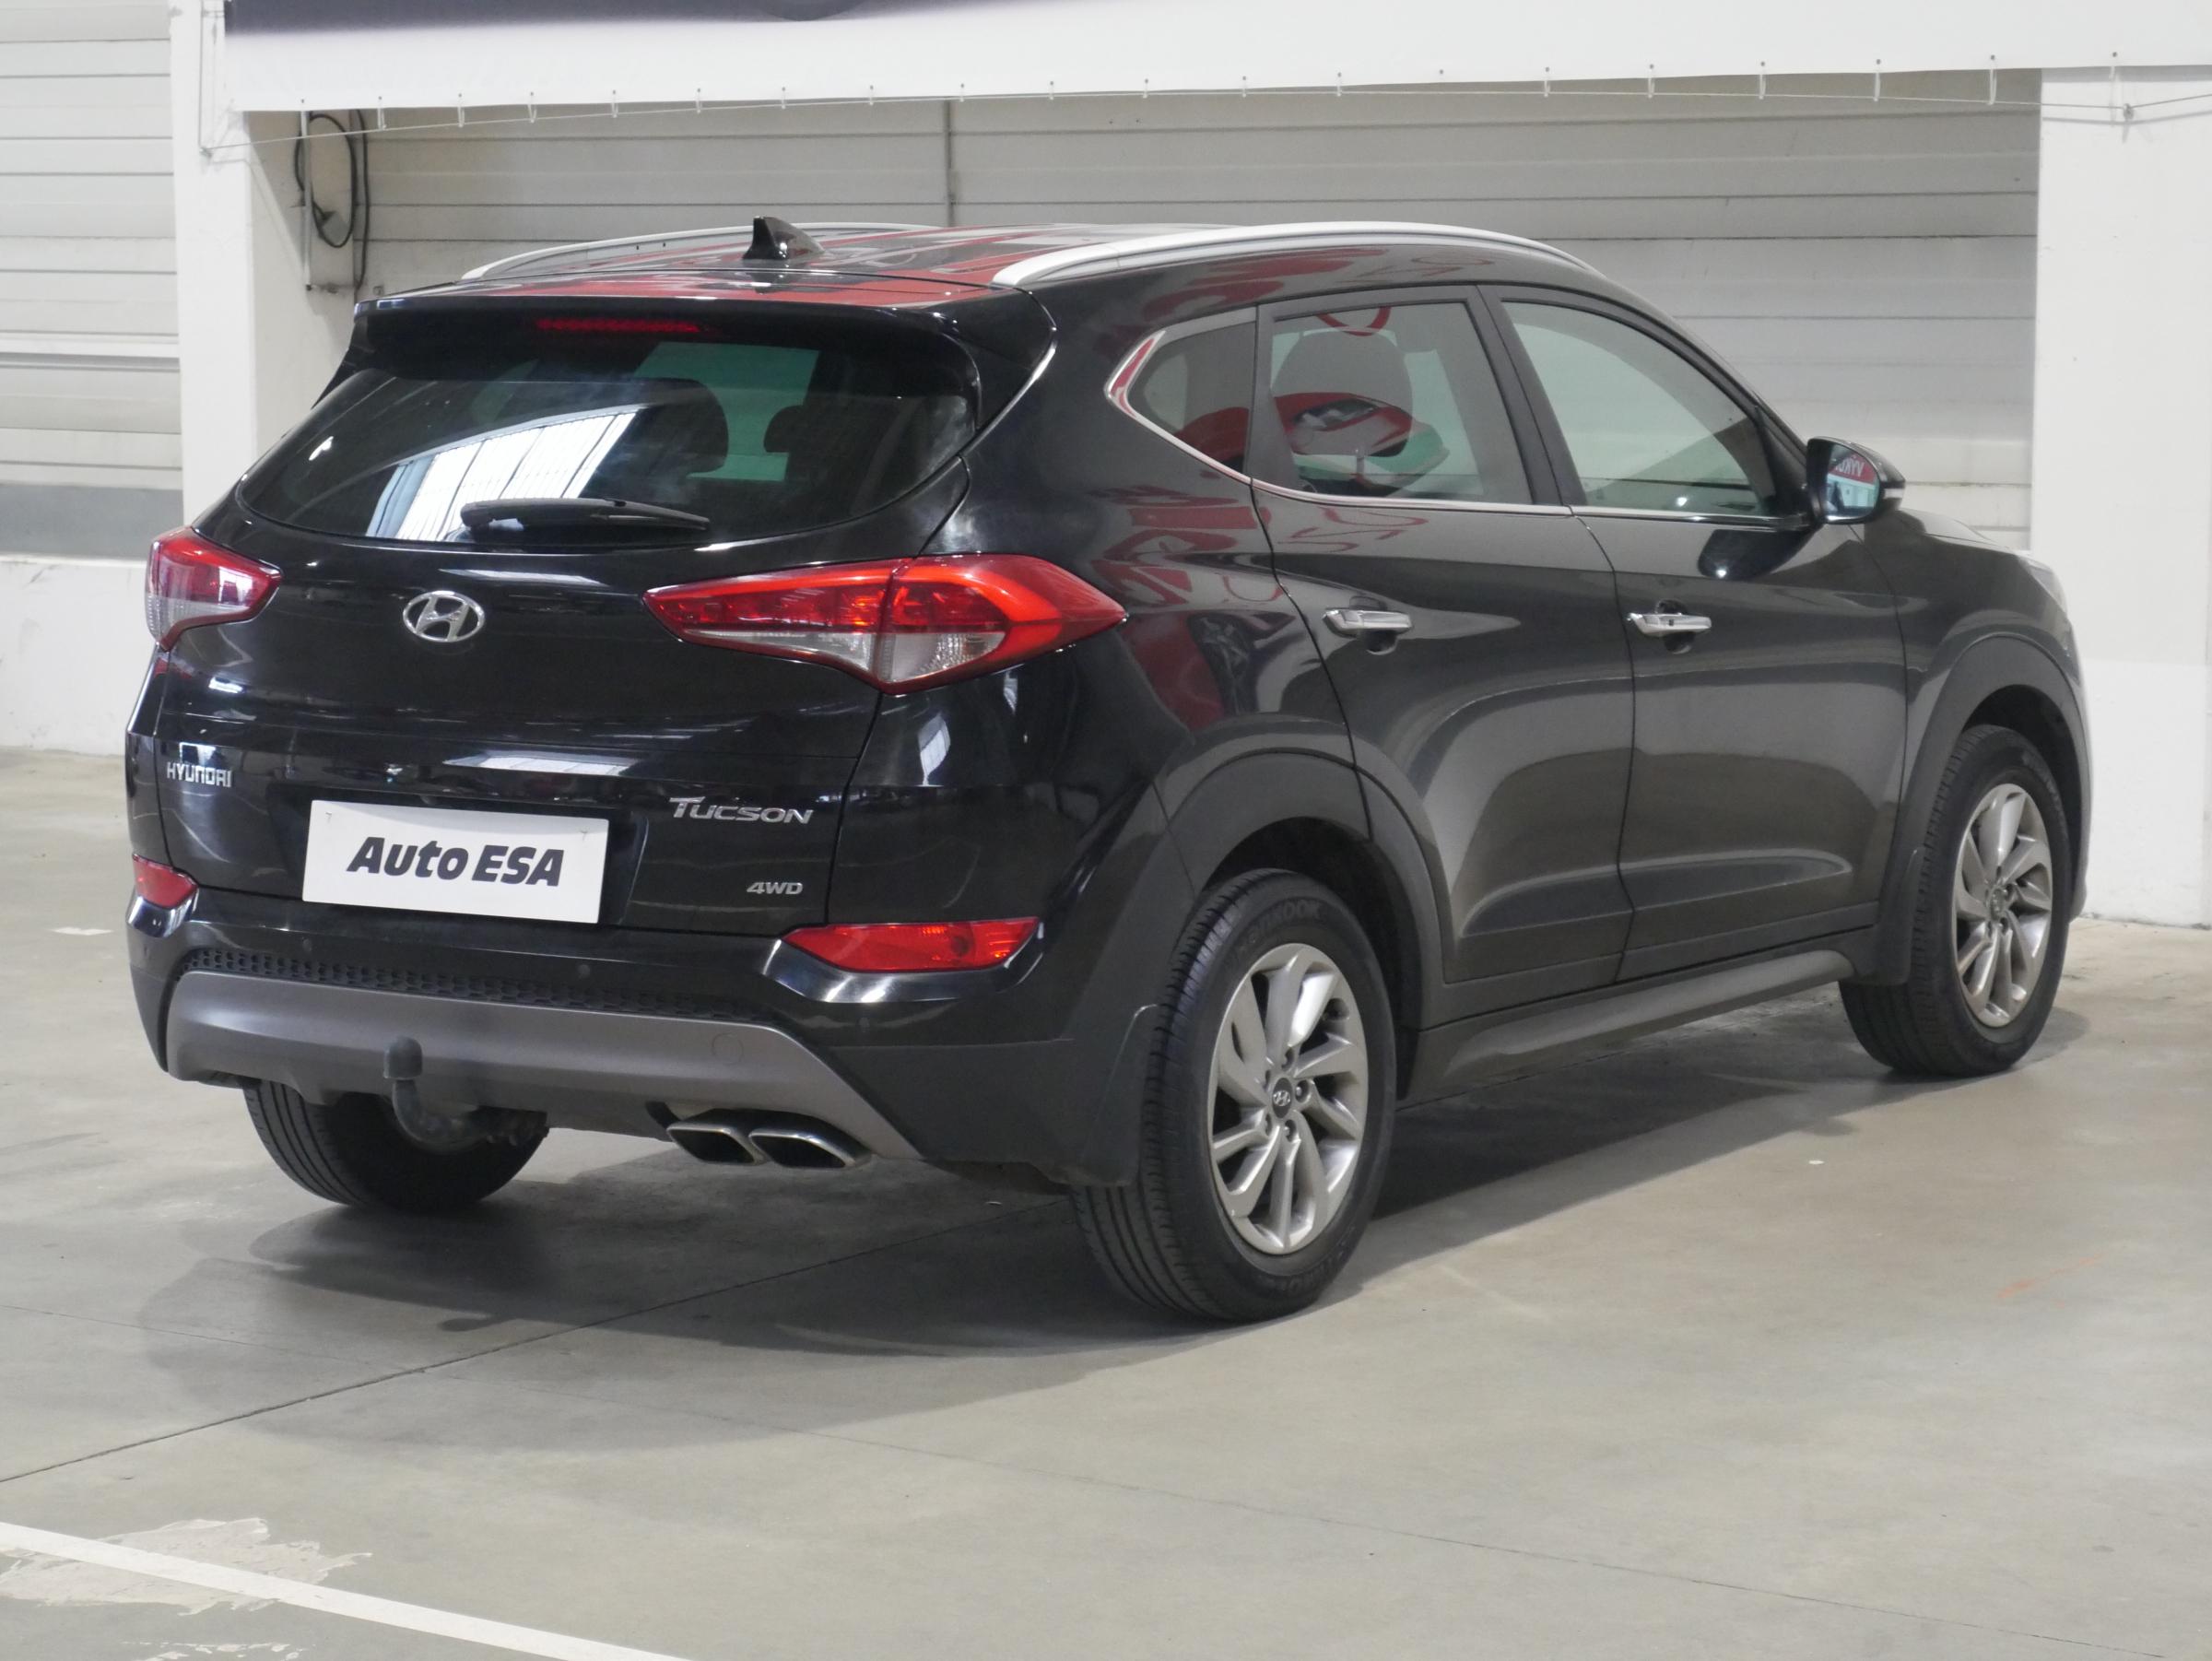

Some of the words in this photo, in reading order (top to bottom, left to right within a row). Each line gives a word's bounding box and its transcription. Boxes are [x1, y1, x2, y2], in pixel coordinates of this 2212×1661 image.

[166, 761, 232, 788] HYUNDAI
[346, 836, 469, 880] Auto
[471, 844, 565, 887] ESA
[747, 882, 804, 895] 4WD
